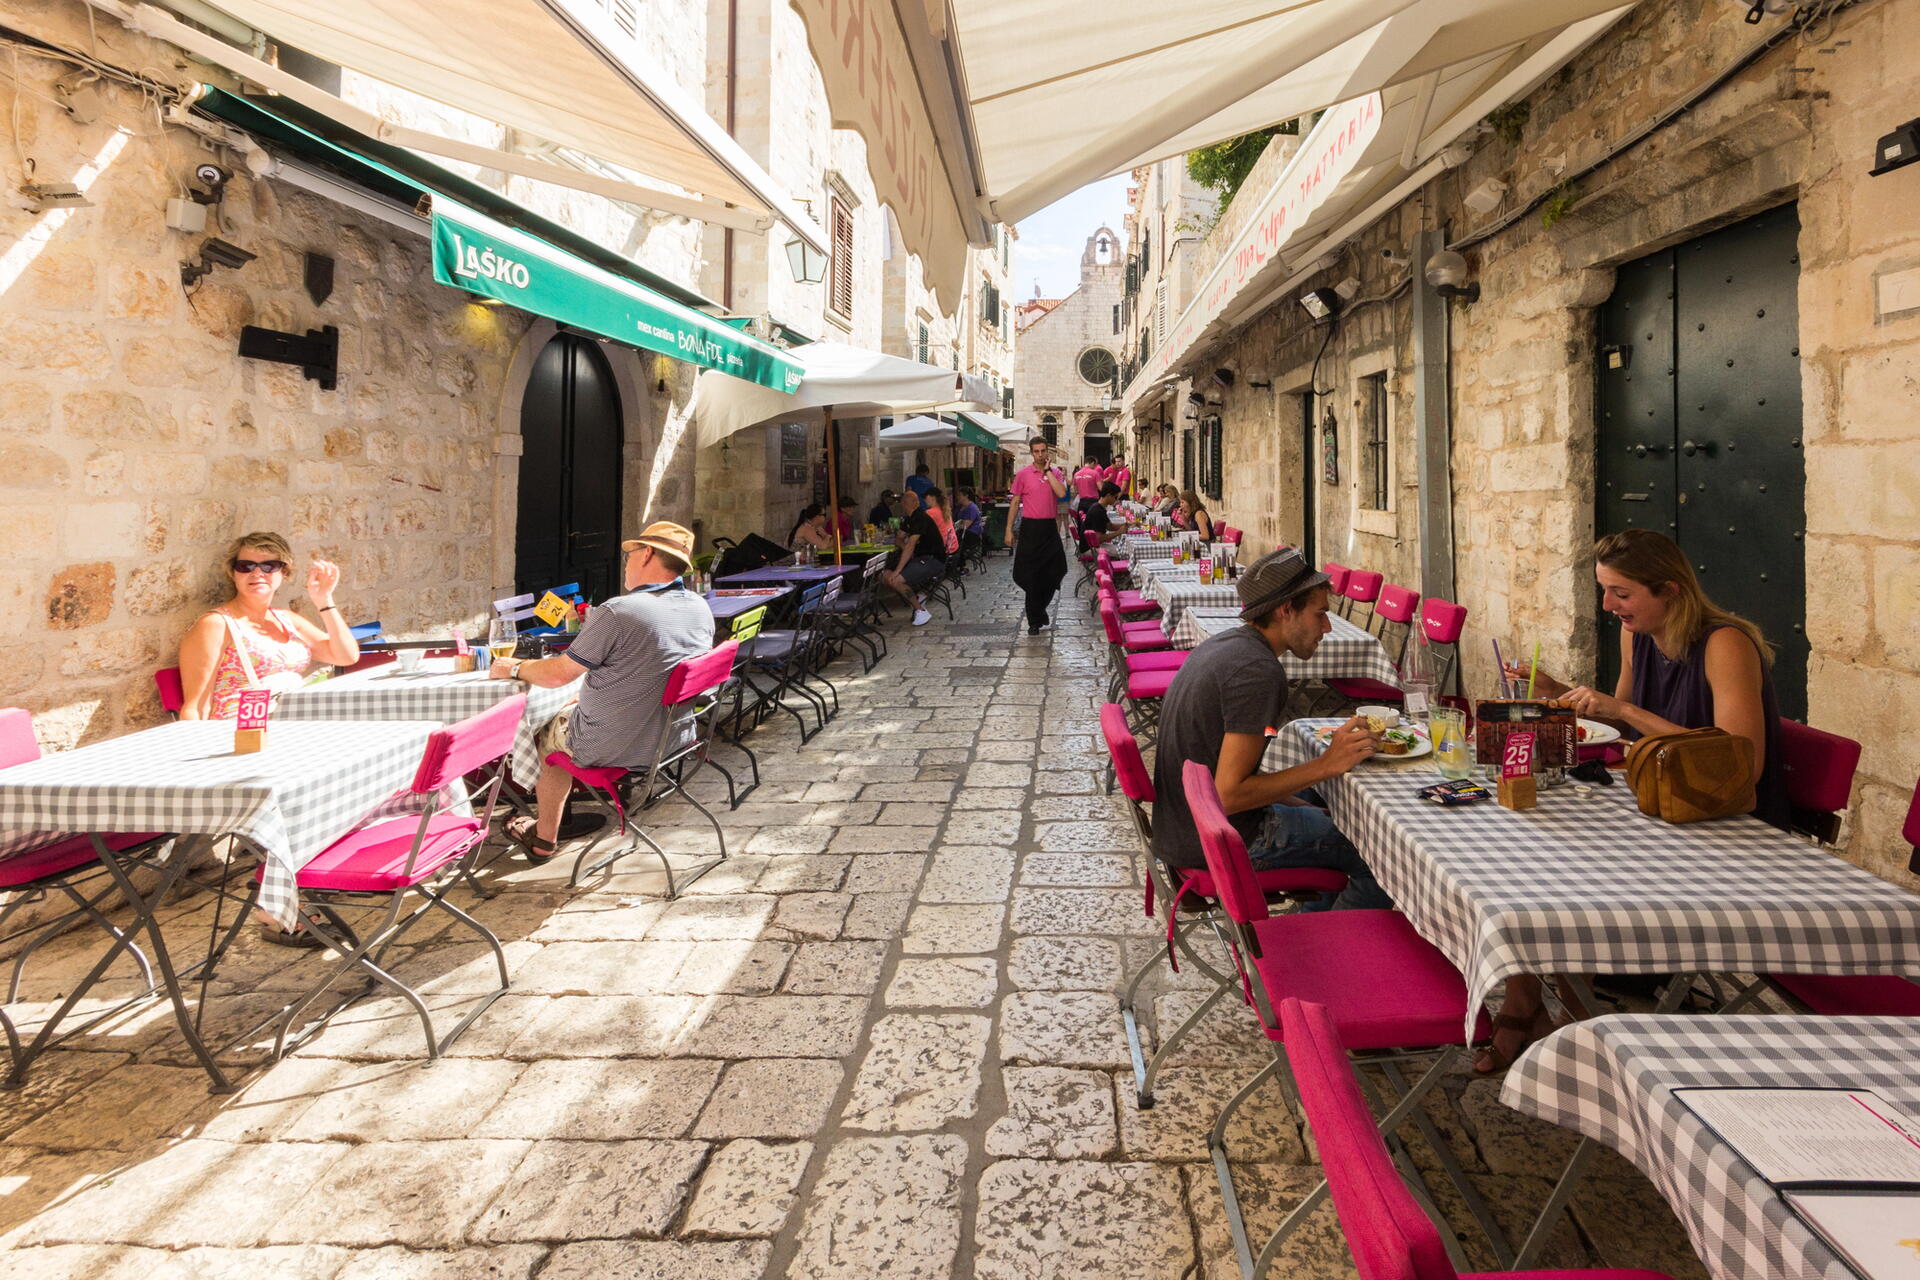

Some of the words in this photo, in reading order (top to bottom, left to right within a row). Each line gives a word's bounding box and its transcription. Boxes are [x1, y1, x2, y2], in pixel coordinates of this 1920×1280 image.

[1300, 95, 1373, 202] TRATTORIA
[453, 233, 530, 289] LAŠKO
[637, 320, 652, 335] mex
[678, 329, 705, 357] BONA
[1201, 564, 1211, 572] 23
[551, 605, 564, 617] 24
[240, 702, 266, 719] 30
[1505, 745, 1530, 765] 25
